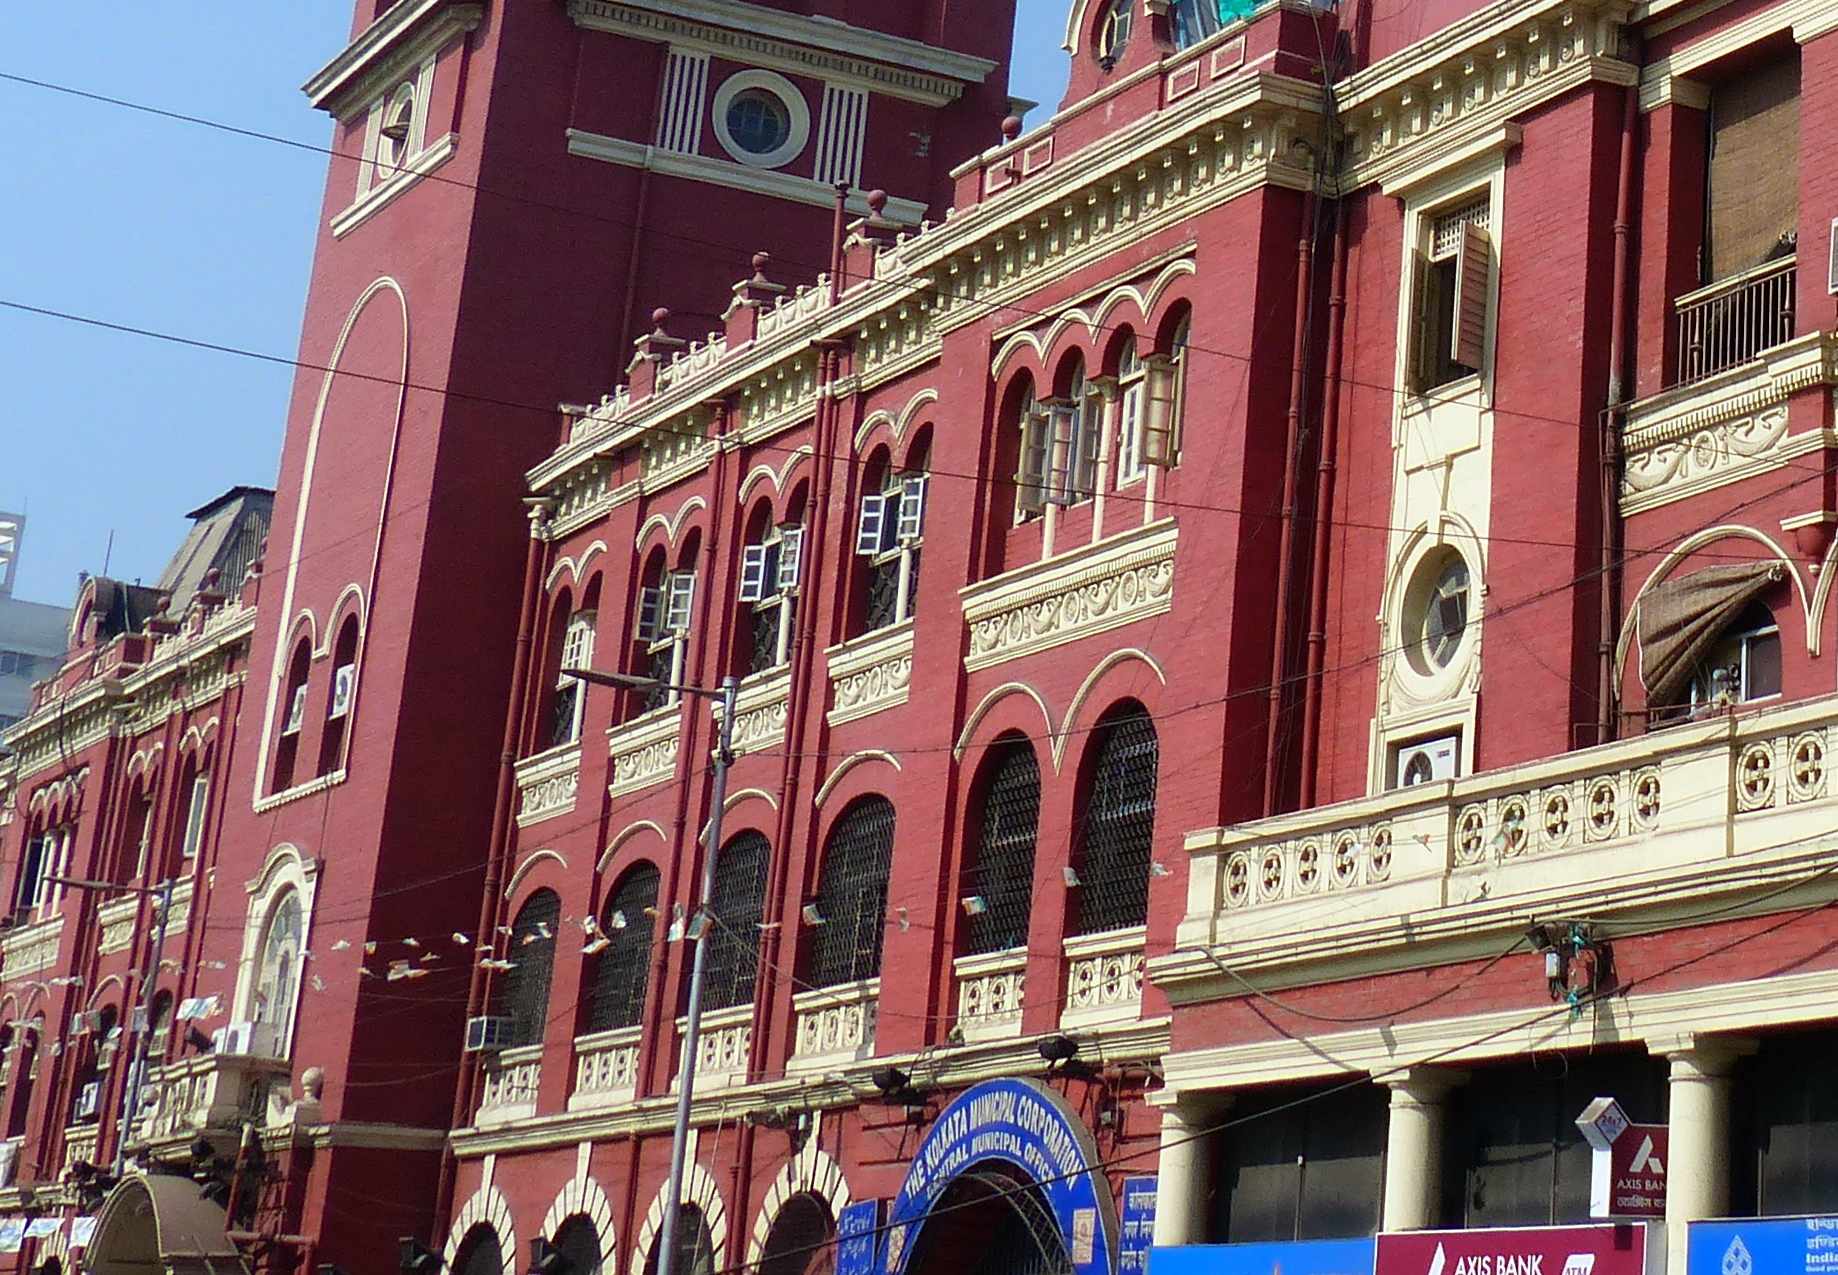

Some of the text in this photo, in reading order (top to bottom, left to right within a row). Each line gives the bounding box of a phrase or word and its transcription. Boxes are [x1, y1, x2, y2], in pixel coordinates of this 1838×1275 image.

[905, 1090, 1084, 1199] THE KOLKATA MUNICIPAL CORPORATION
[971, 1131, 1021, 1157] MUNICIPAL
[1617, 1180, 1642, 1190] AXIS
[1454, 1255, 1491, 1275] AXIS
[1497, 1255, 1543, 1275] BANK
